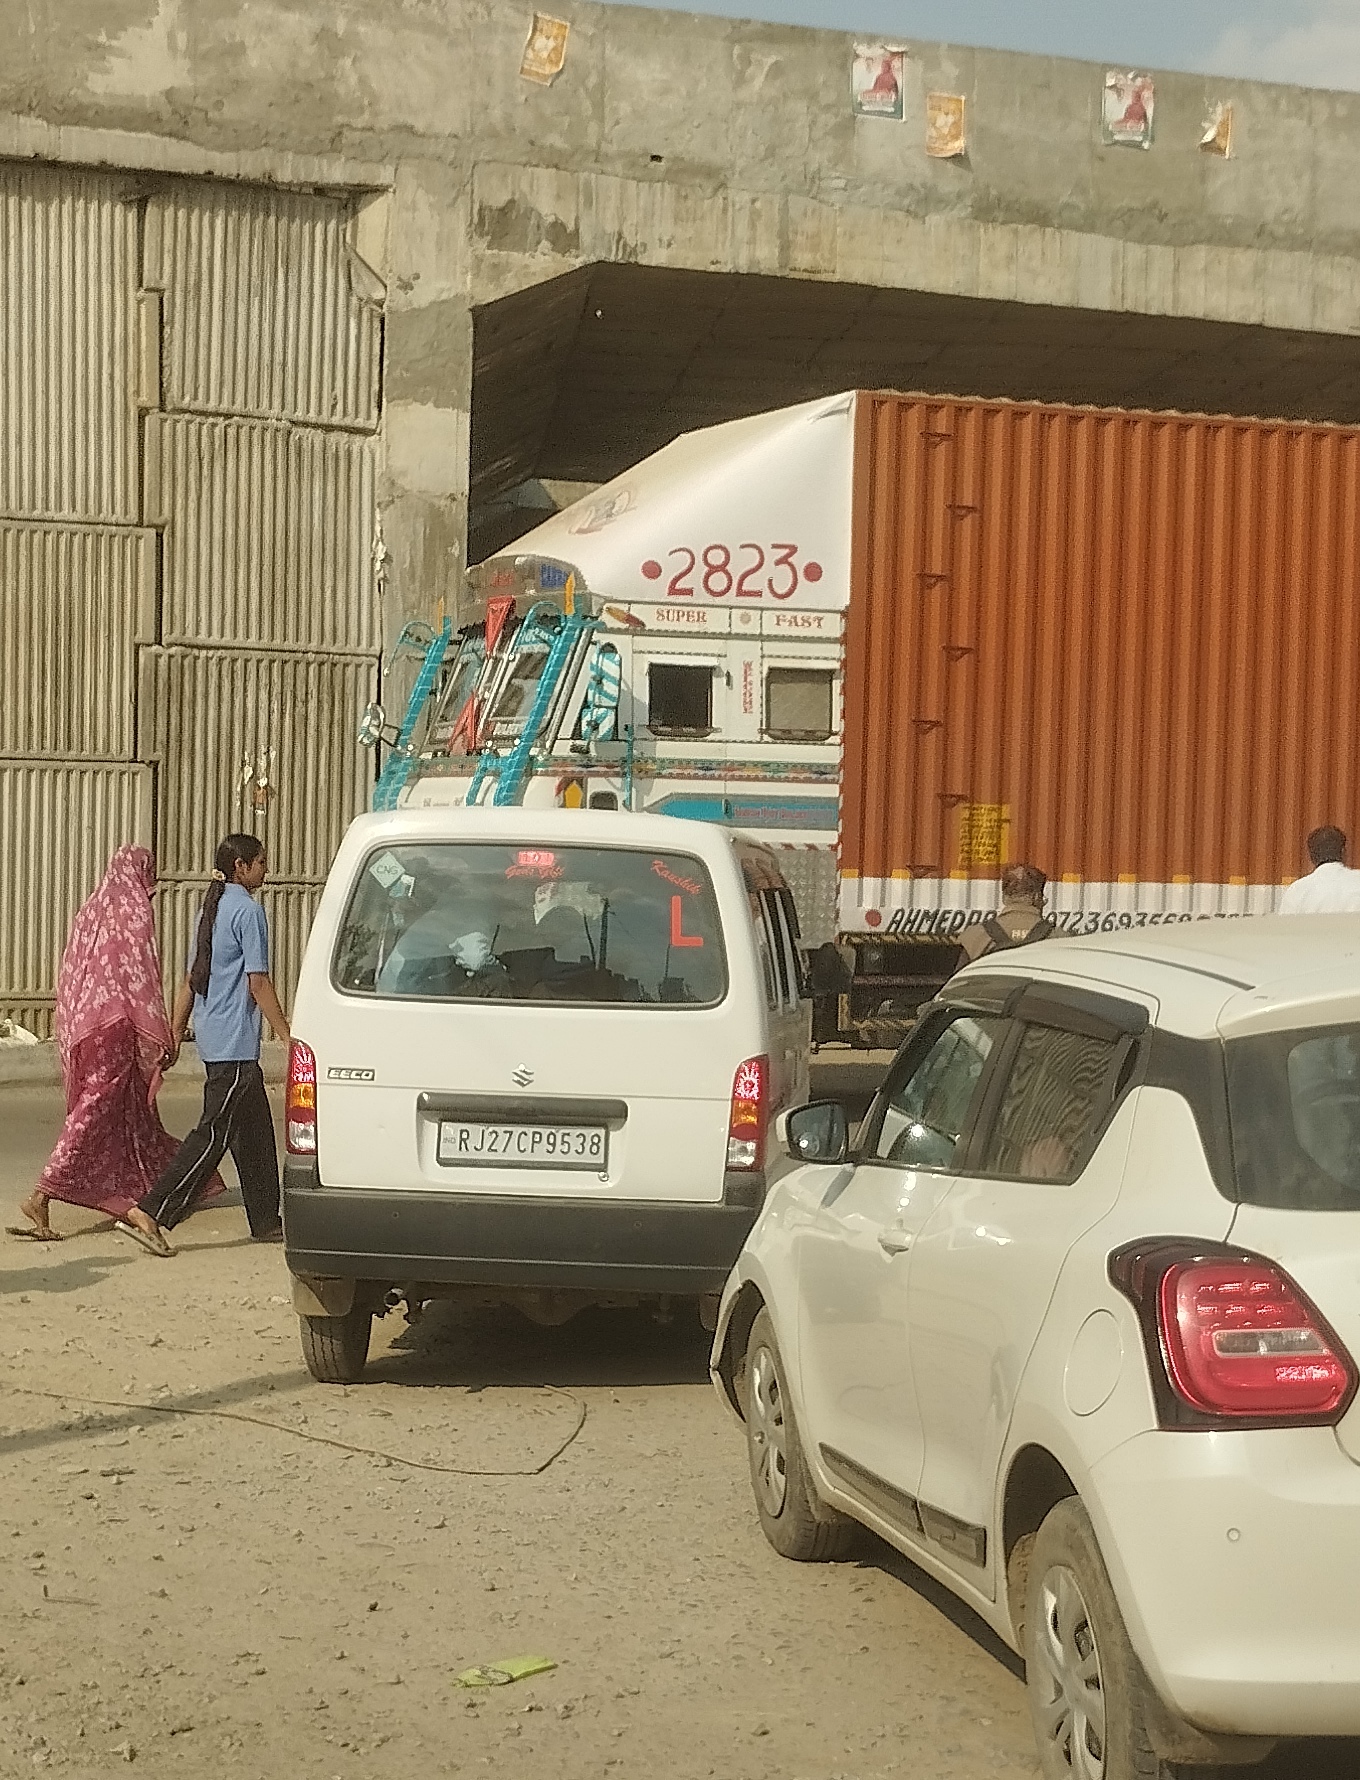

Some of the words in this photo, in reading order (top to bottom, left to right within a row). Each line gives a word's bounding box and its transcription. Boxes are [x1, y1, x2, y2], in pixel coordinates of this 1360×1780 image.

[667, 543, 798, 599] 2823
[655, 608, 708, 623] SUPER
[774, 614, 825, 629] FAST
[376, 865, 399, 875] CNG
[671, 895, 704, 947] L
[328, 1068, 374, 1080] EECO
[458, 1128, 602, 1156] RJ27CP9538
